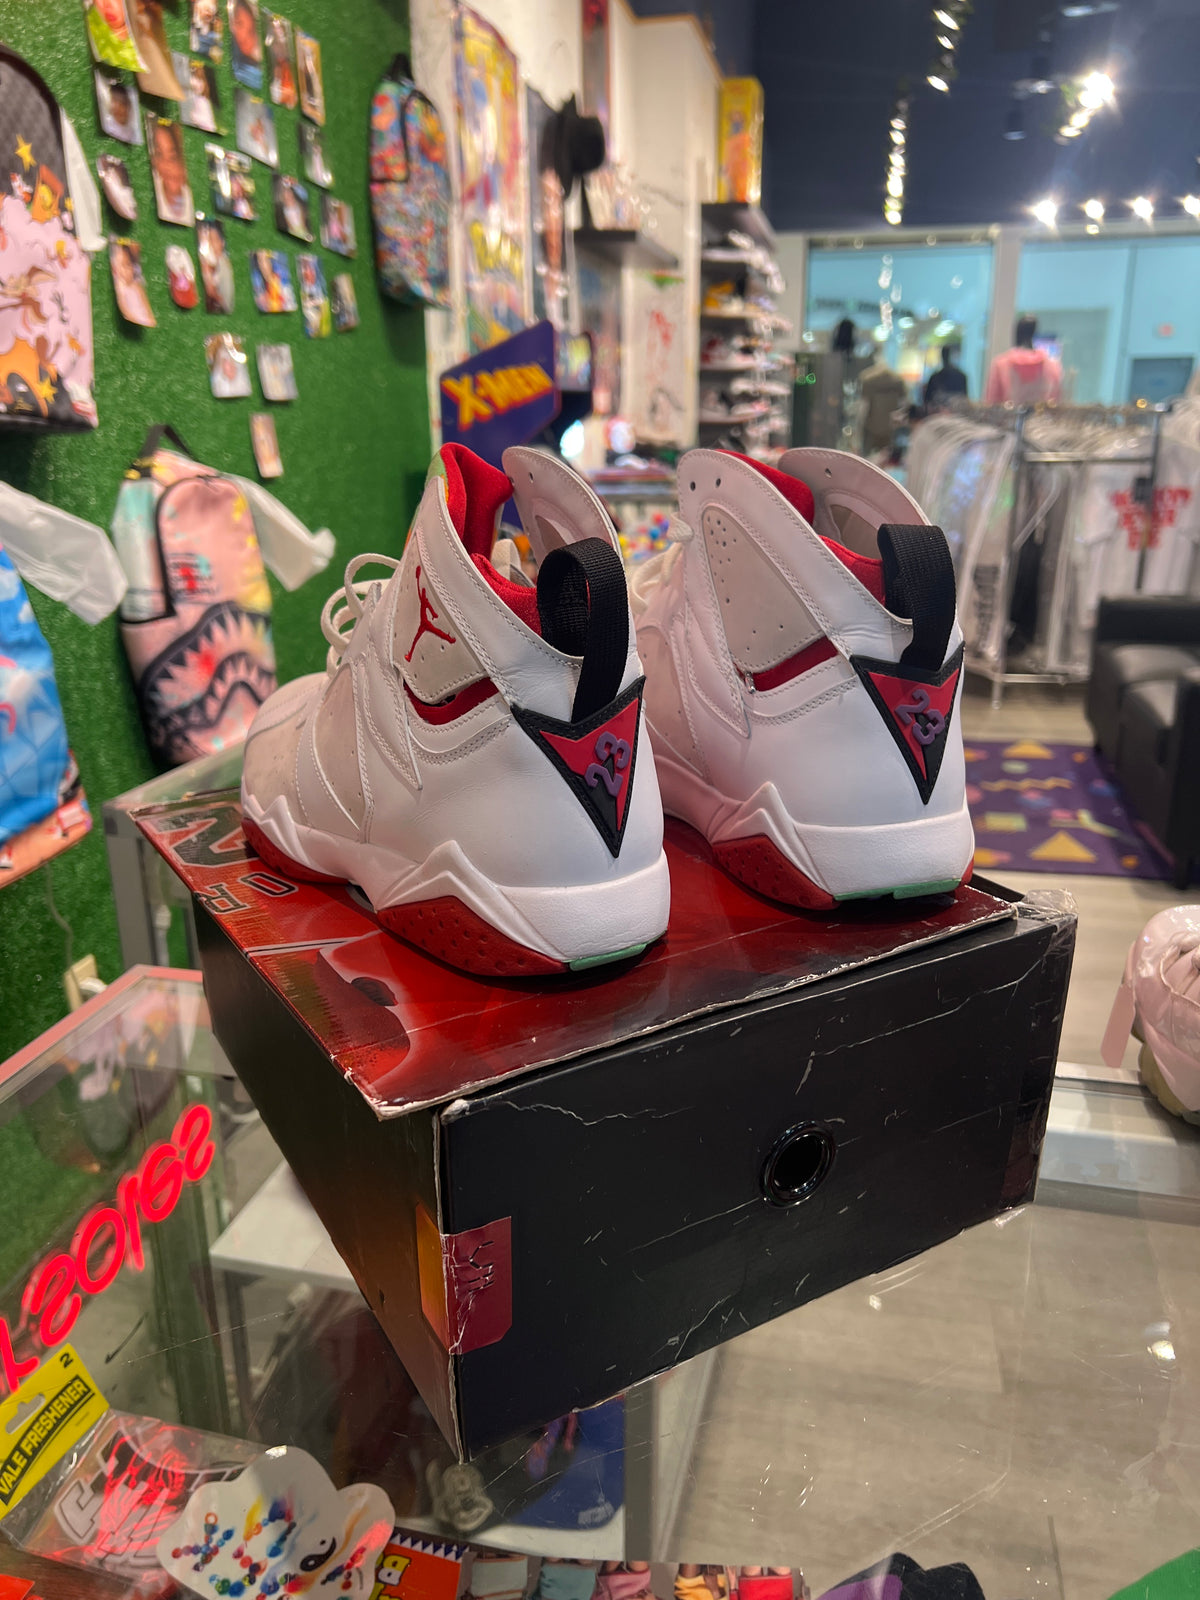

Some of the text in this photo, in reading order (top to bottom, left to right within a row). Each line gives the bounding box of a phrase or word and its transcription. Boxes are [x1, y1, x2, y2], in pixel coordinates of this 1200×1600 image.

[440, 364, 554, 432] X-MEN
[894, 687, 946, 746] 23
[584, 730, 632, 798] 23
[60, 1352, 74, 1369] 2
[20, 1379, 88, 1456] FRESHENER
